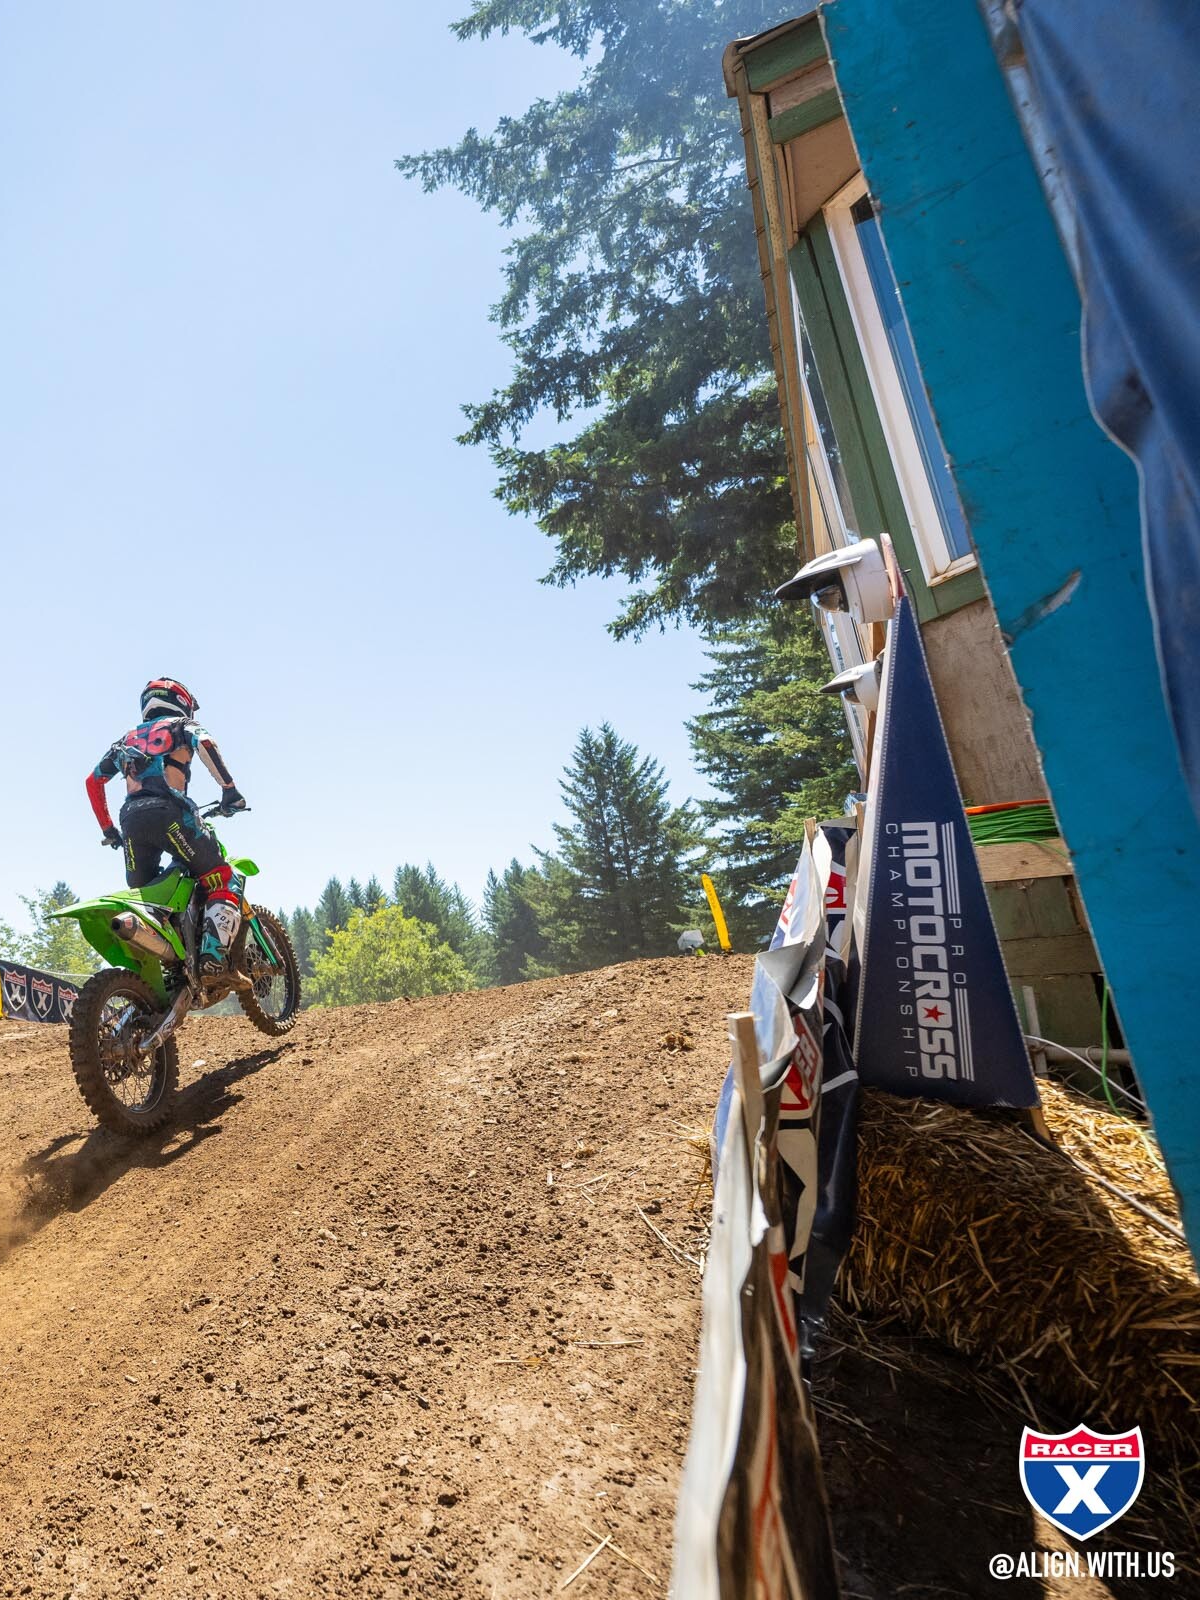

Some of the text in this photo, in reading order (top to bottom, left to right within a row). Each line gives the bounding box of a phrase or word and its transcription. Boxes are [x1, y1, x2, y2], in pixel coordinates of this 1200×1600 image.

[126, 720, 173, 756] 56
[884, 822, 919, 1078] CHAMPIONSHIP
[900, 821, 958, 1081] MOTOCROSS
[949, 917, 968, 985] PRO
[10, 983, 23, 1003] X
[37, 991, 48, 1011] X
[63, 1000, 74, 1018] X
